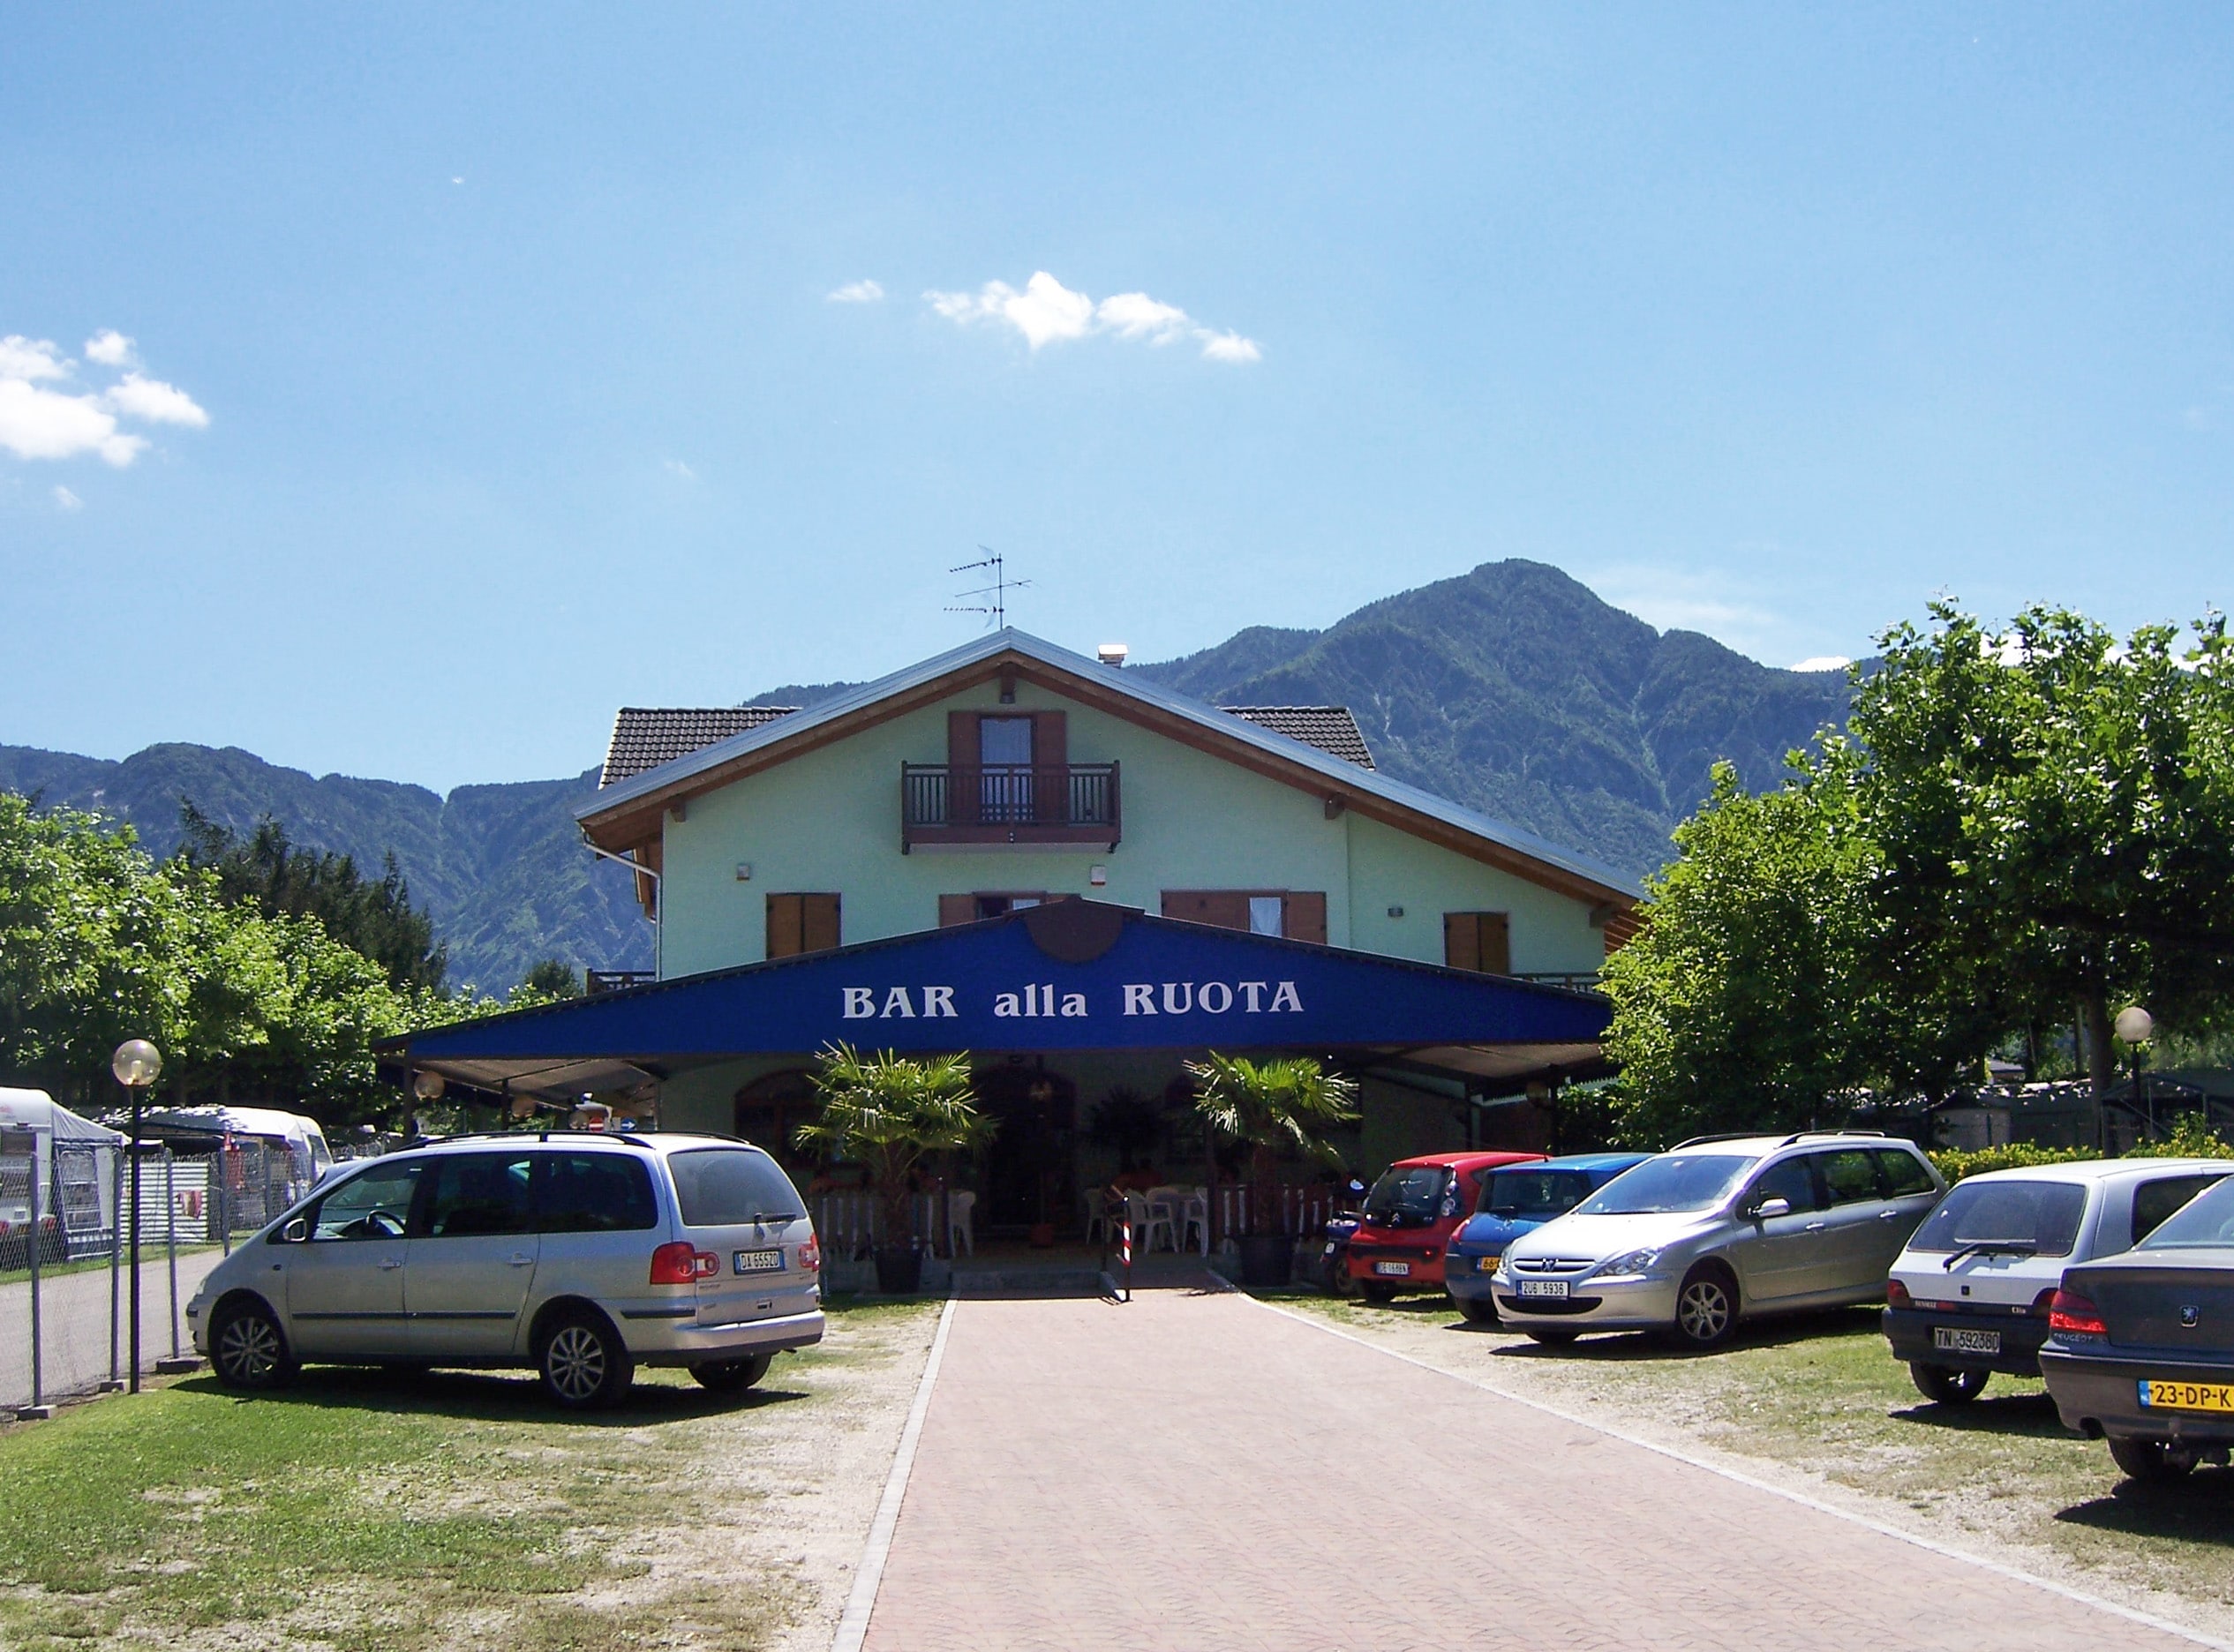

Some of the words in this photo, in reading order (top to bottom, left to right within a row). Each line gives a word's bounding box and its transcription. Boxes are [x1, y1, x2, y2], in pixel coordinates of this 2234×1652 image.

[842, 987, 959, 1018] BAR
[994, 983, 1088, 1017] alla
[1122, 981, 1305, 1016] RUOTA
[741, 1254, 752, 1268] DA
[1523, 1282, 1538, 1295] 2U6
[1543, 1282, 1564, 1295] 5936
[1936, 1329, 1952, 1348] TN
[1958, 1331, 1999, 1351] 592380
[2053, 1333, 2094, 1343] PEUGEOT
[2155, 1384, 2232, 1408] 23-DP-K
